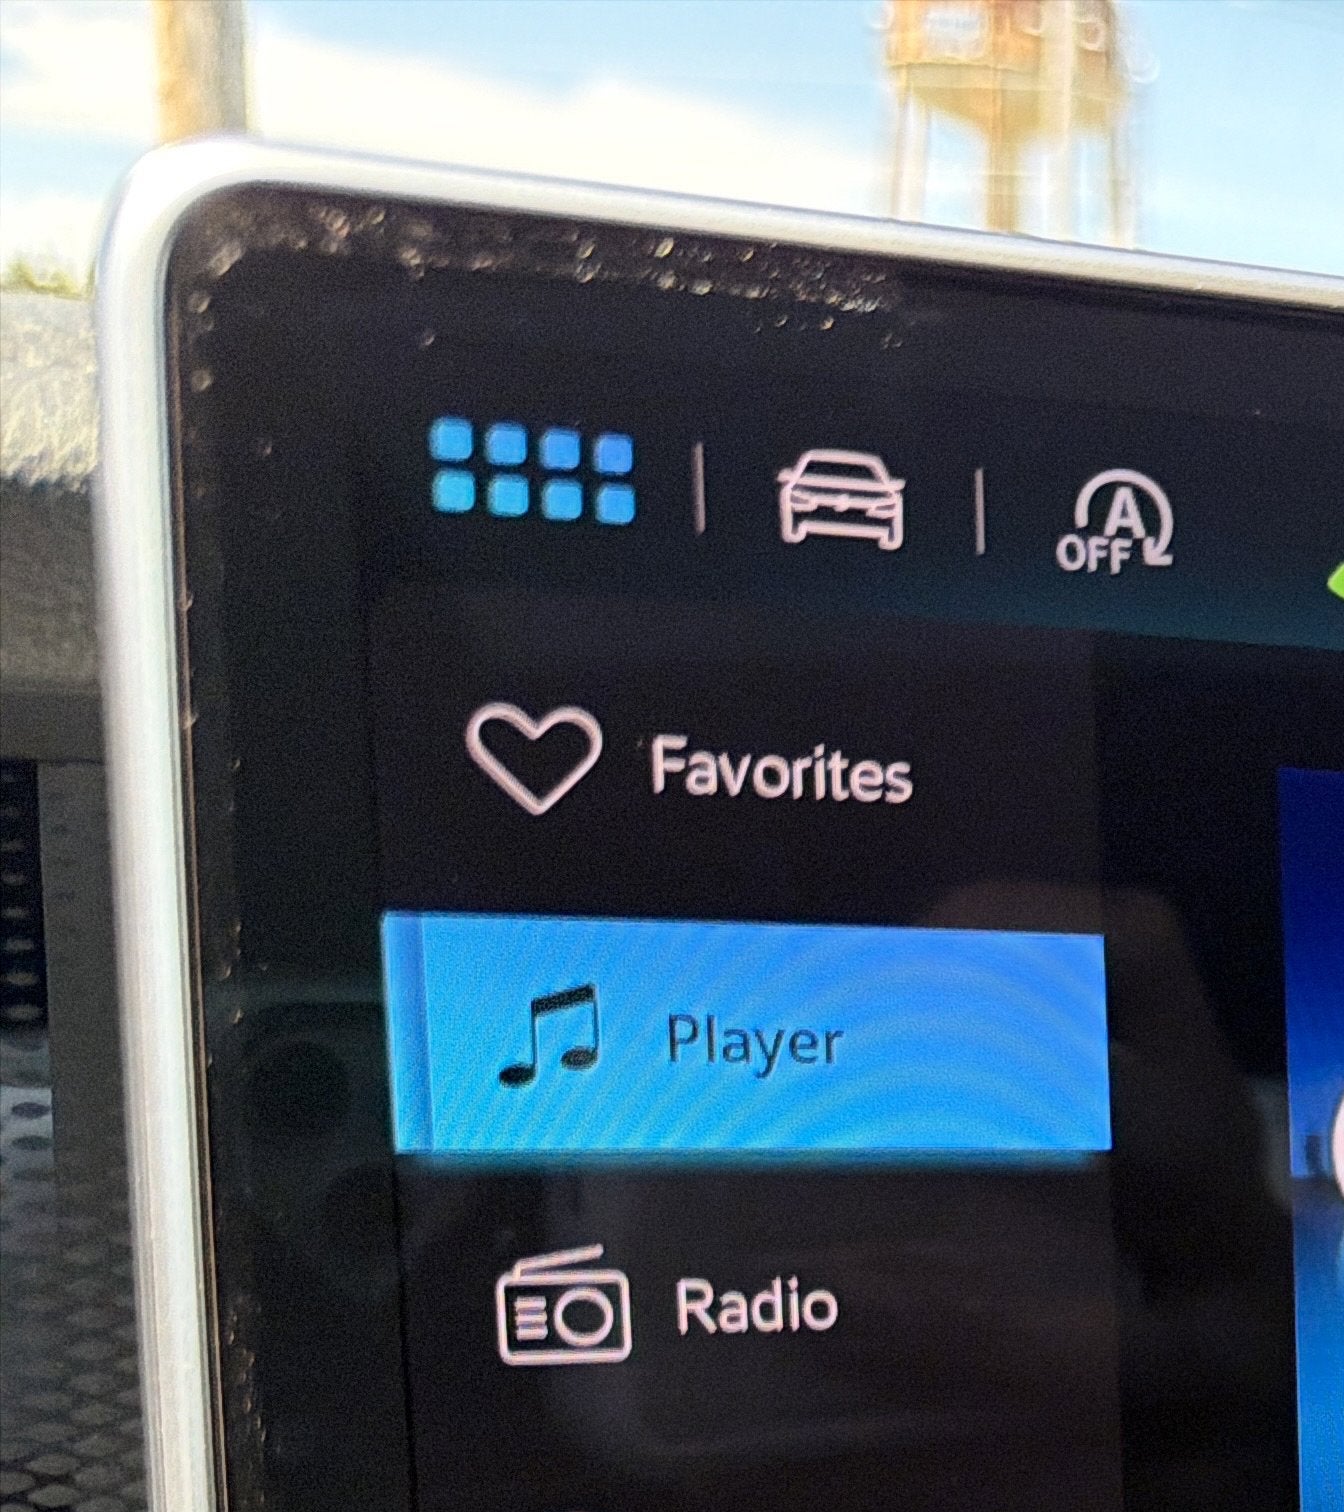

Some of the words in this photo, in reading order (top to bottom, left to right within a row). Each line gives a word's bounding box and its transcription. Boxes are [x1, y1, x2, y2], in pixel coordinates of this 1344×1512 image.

[1103, 485, 1146, 539] A
[1055, 533, 1133, 575] OFF
[650, 733, 914, 804] Favorites
[667, 1012, 845, 1078] Player
[675, 1275, 840, 1337] Radio
